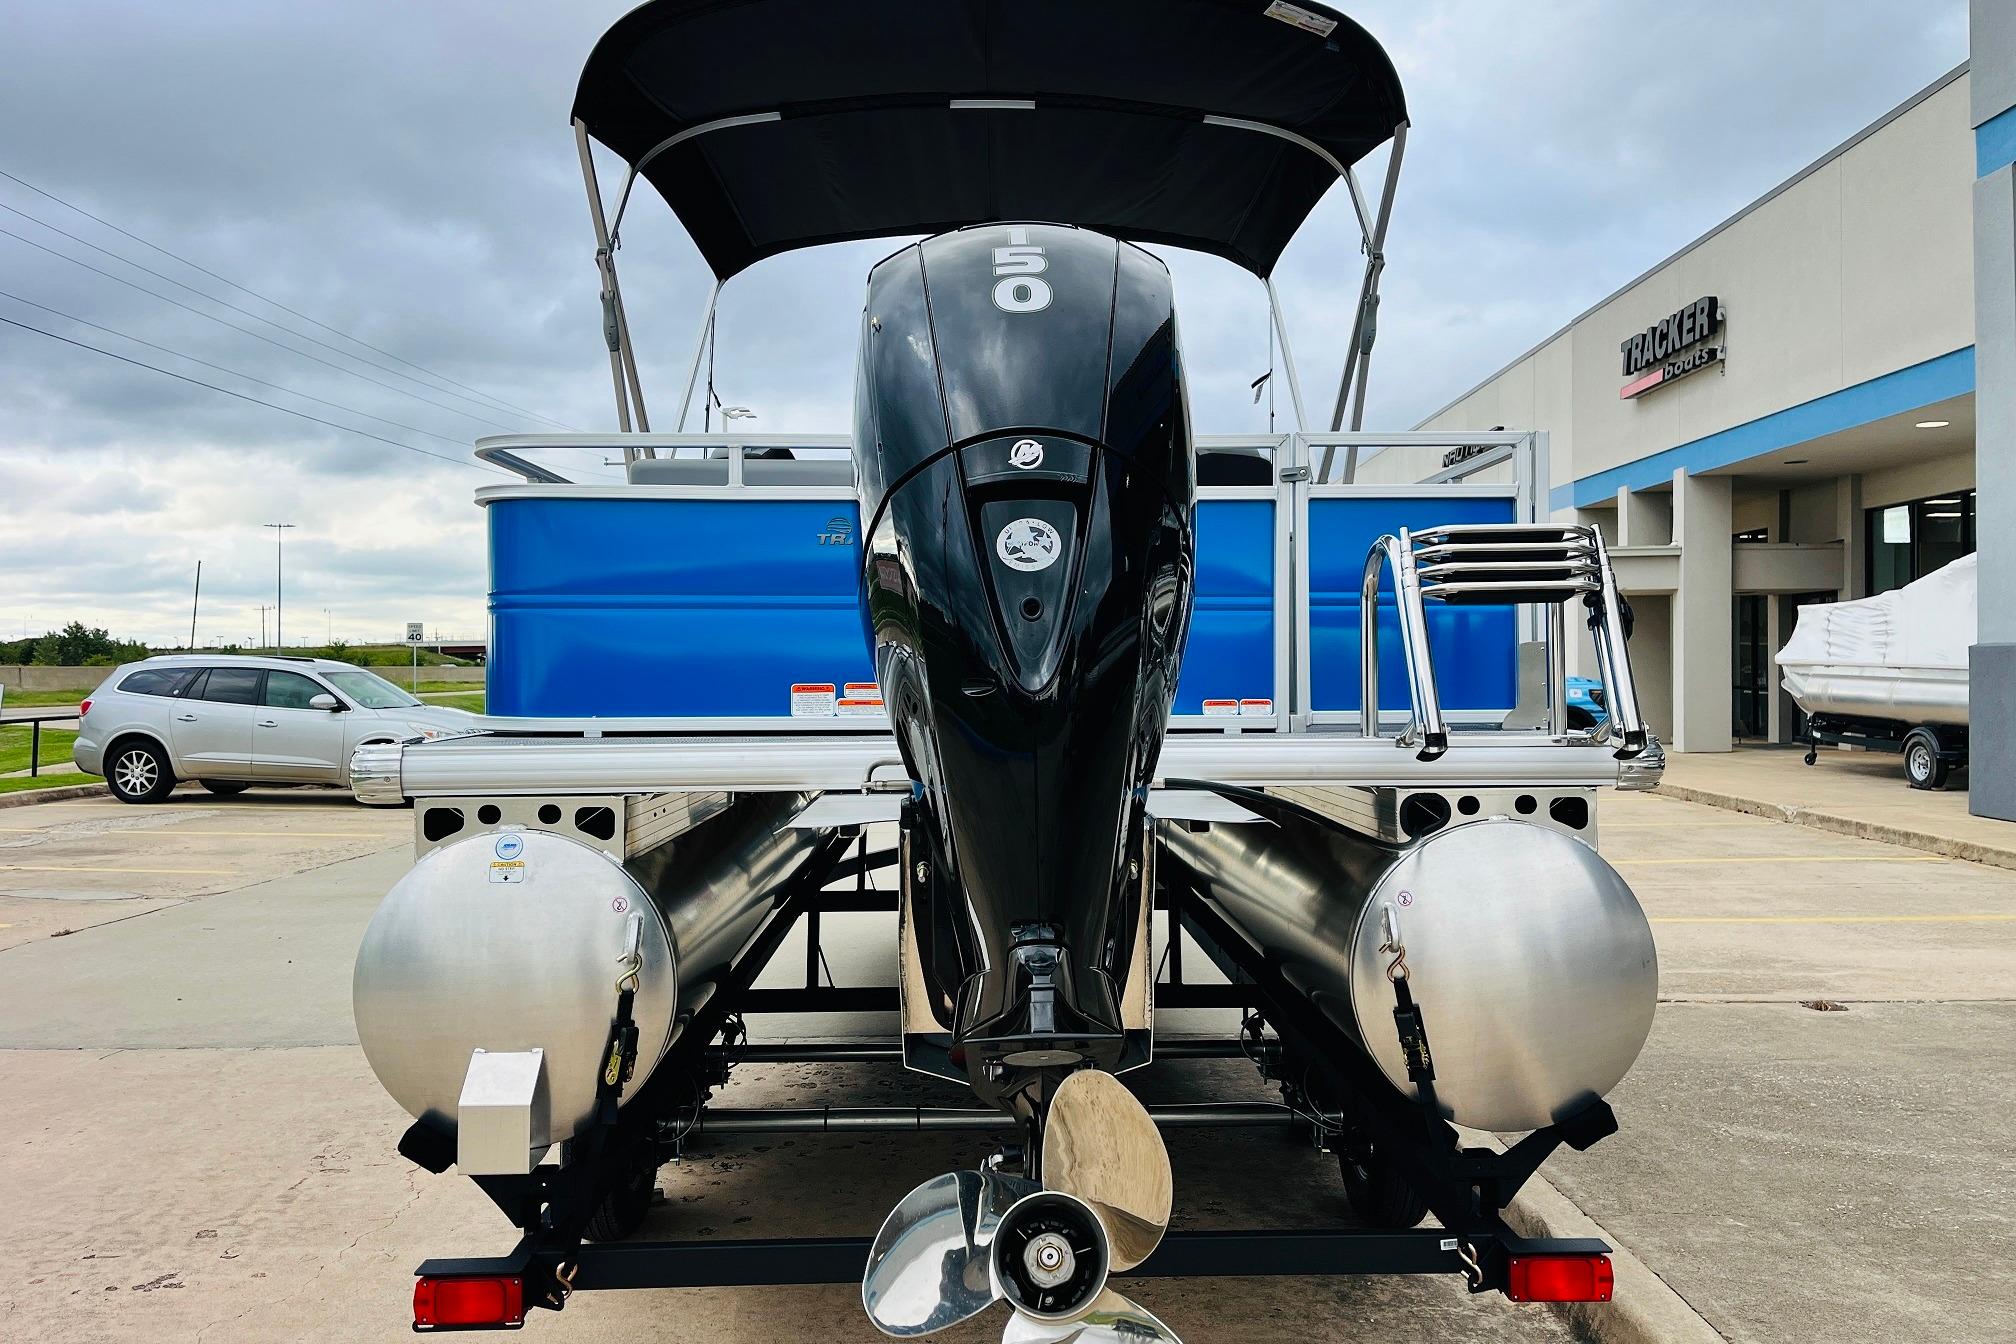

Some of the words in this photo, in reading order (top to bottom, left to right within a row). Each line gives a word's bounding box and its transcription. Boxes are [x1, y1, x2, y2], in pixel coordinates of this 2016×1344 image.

[991, 226, 1053, 313] 150
[1621, 297, 1711, 376] TRACKER
[1664, 347, 1709, 379] boats
[408, 633, 422, 641] 40
